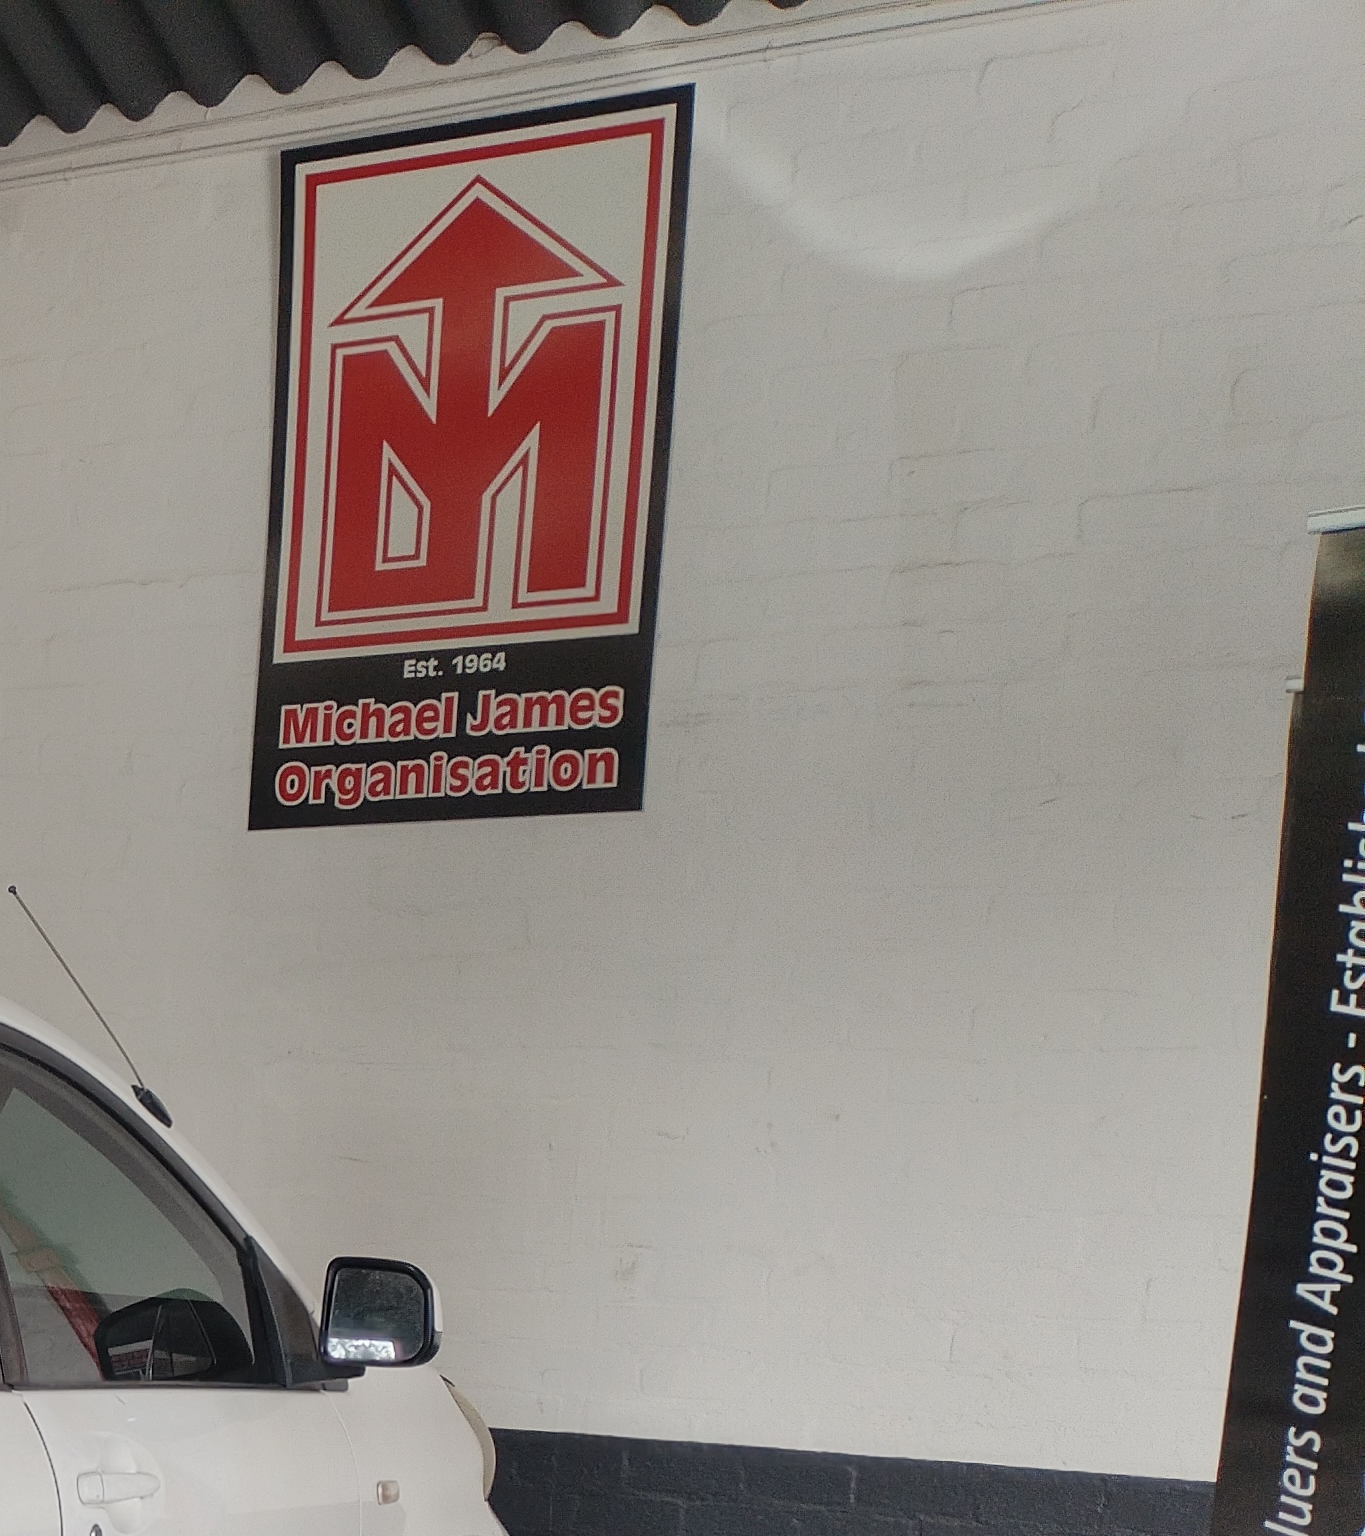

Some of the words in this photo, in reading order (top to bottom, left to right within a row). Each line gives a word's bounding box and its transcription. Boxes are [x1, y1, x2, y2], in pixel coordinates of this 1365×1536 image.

[403, 656, 444, 679] Est.
[452, 651, 507, 675] 1964
[278, 691, 459, 750] Michael
[466, 685, 625, 737] James
[275, 744, 619, 810] Organisation
[1295, 1062, 1365, 1316] Appraisers
[1289, 1319, 1336, 1416] and
